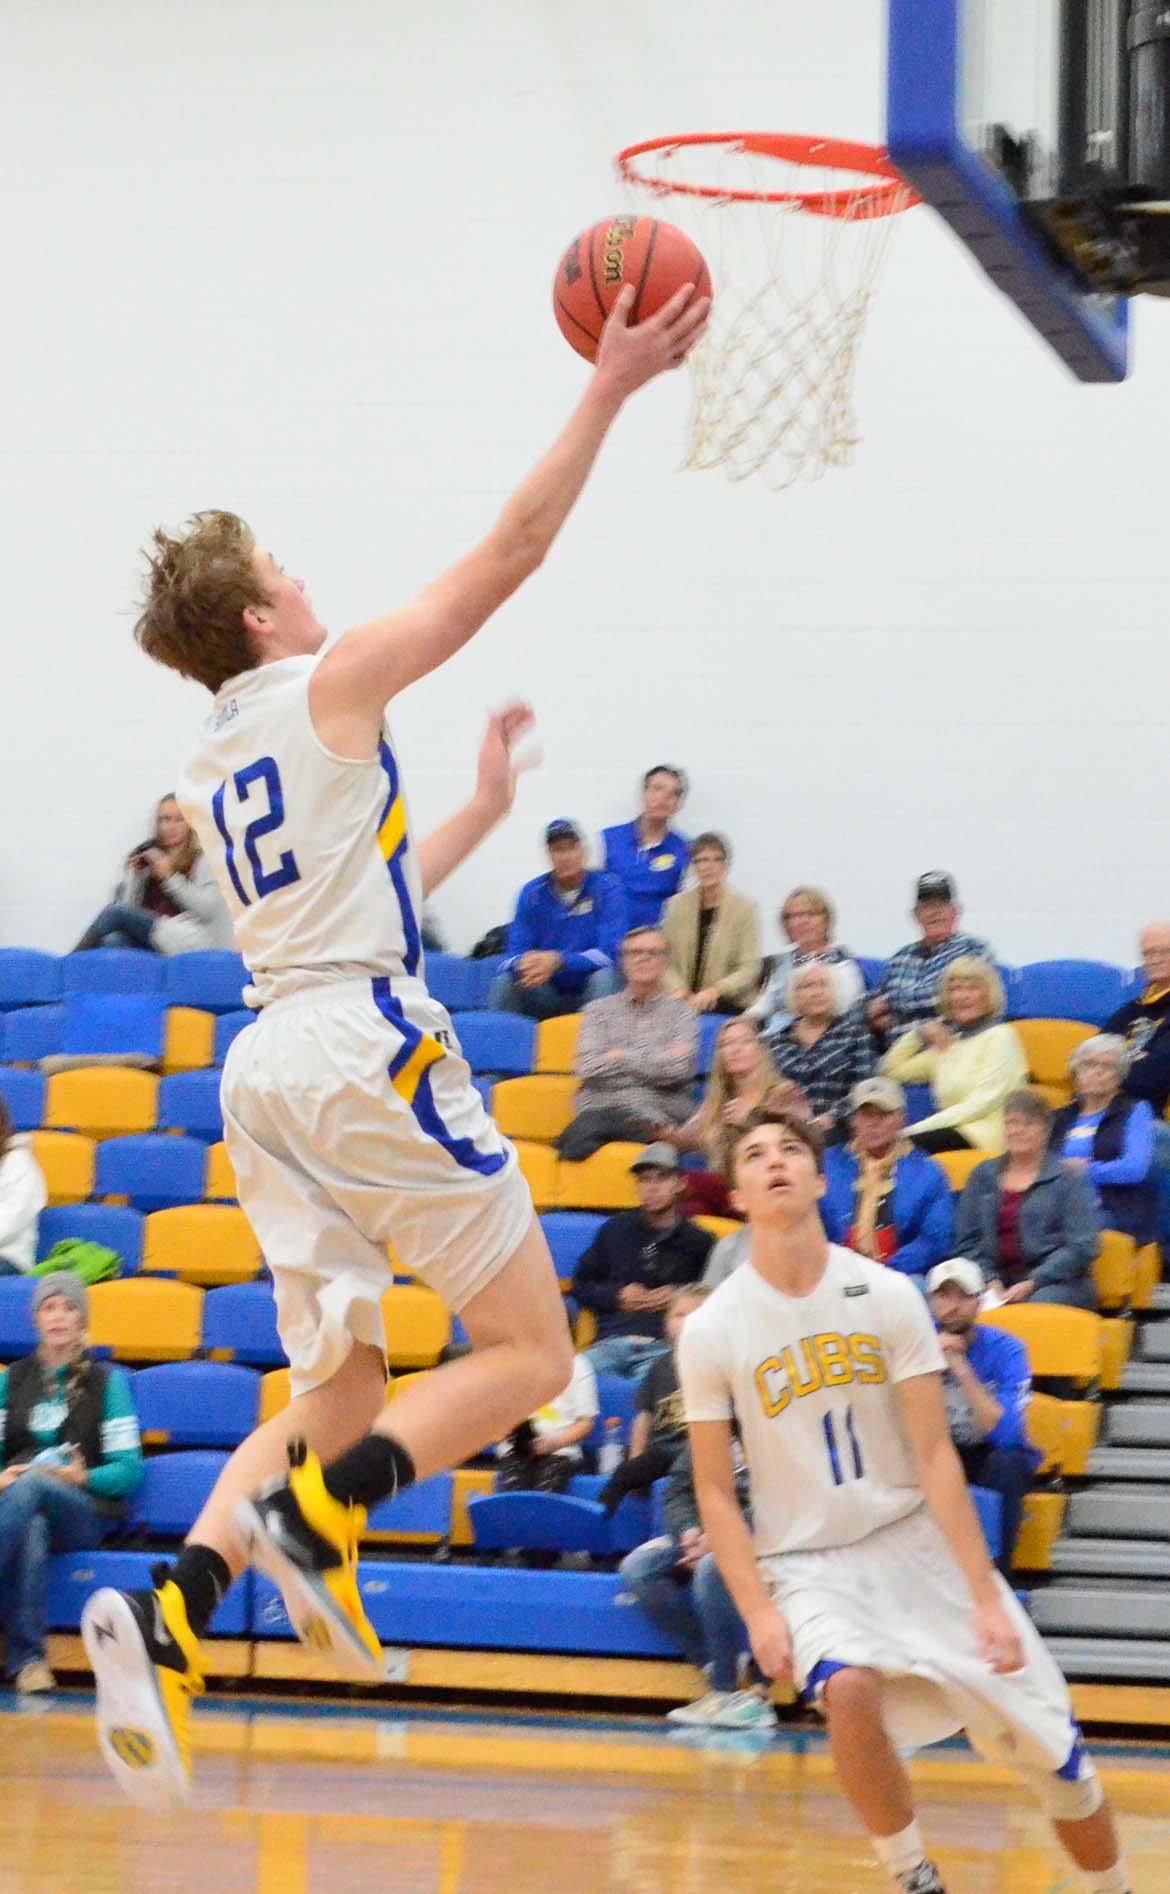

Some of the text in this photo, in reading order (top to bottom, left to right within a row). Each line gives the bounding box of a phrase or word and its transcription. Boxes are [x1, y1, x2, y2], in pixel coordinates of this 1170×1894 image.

[212, 757, 302, 906] 12
[754, 1332, 887, 1419] CUBS
[822, 1403, 864, 1486] 11
